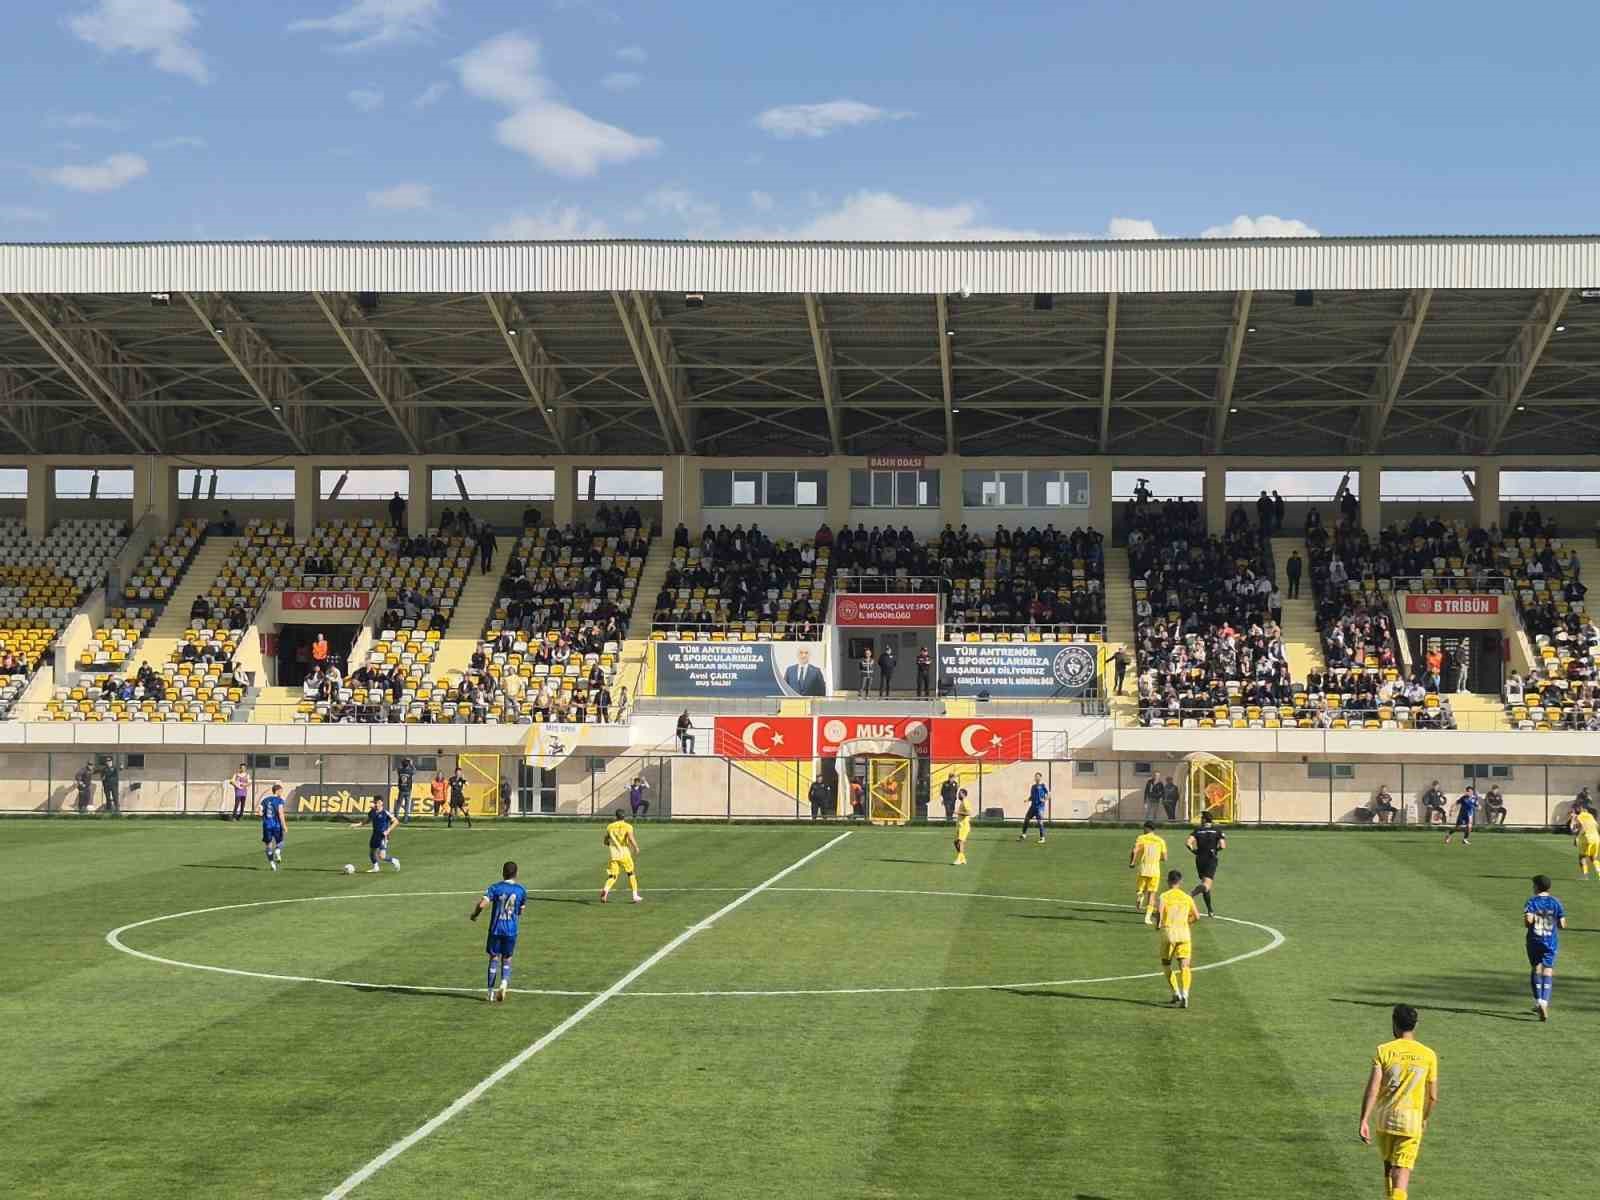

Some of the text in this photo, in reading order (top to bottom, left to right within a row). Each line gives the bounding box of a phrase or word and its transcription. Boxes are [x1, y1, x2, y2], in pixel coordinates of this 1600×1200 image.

[309, 594, 360, 609] C TRİBÜN
[1434, 598, 1489, 613] B TRİBÜN
[679, 645, 753, 654] TÜM ANTRENÖR
[953, 646, 1037, 657] TÜM ANTRENÖR
[668, 654, 764, 663] VE SPORCULARIMIZA
[942, 656, 1050, 666] VE SPORCULARIMIZA
[675, 662, 757, 671] BAŞARILAR DİLİYORUM
[945, 665, 1045, 676] BAŞARILAR DİLİYORUZ
[689, 671, 738, 681] Avni ÇAKIR
